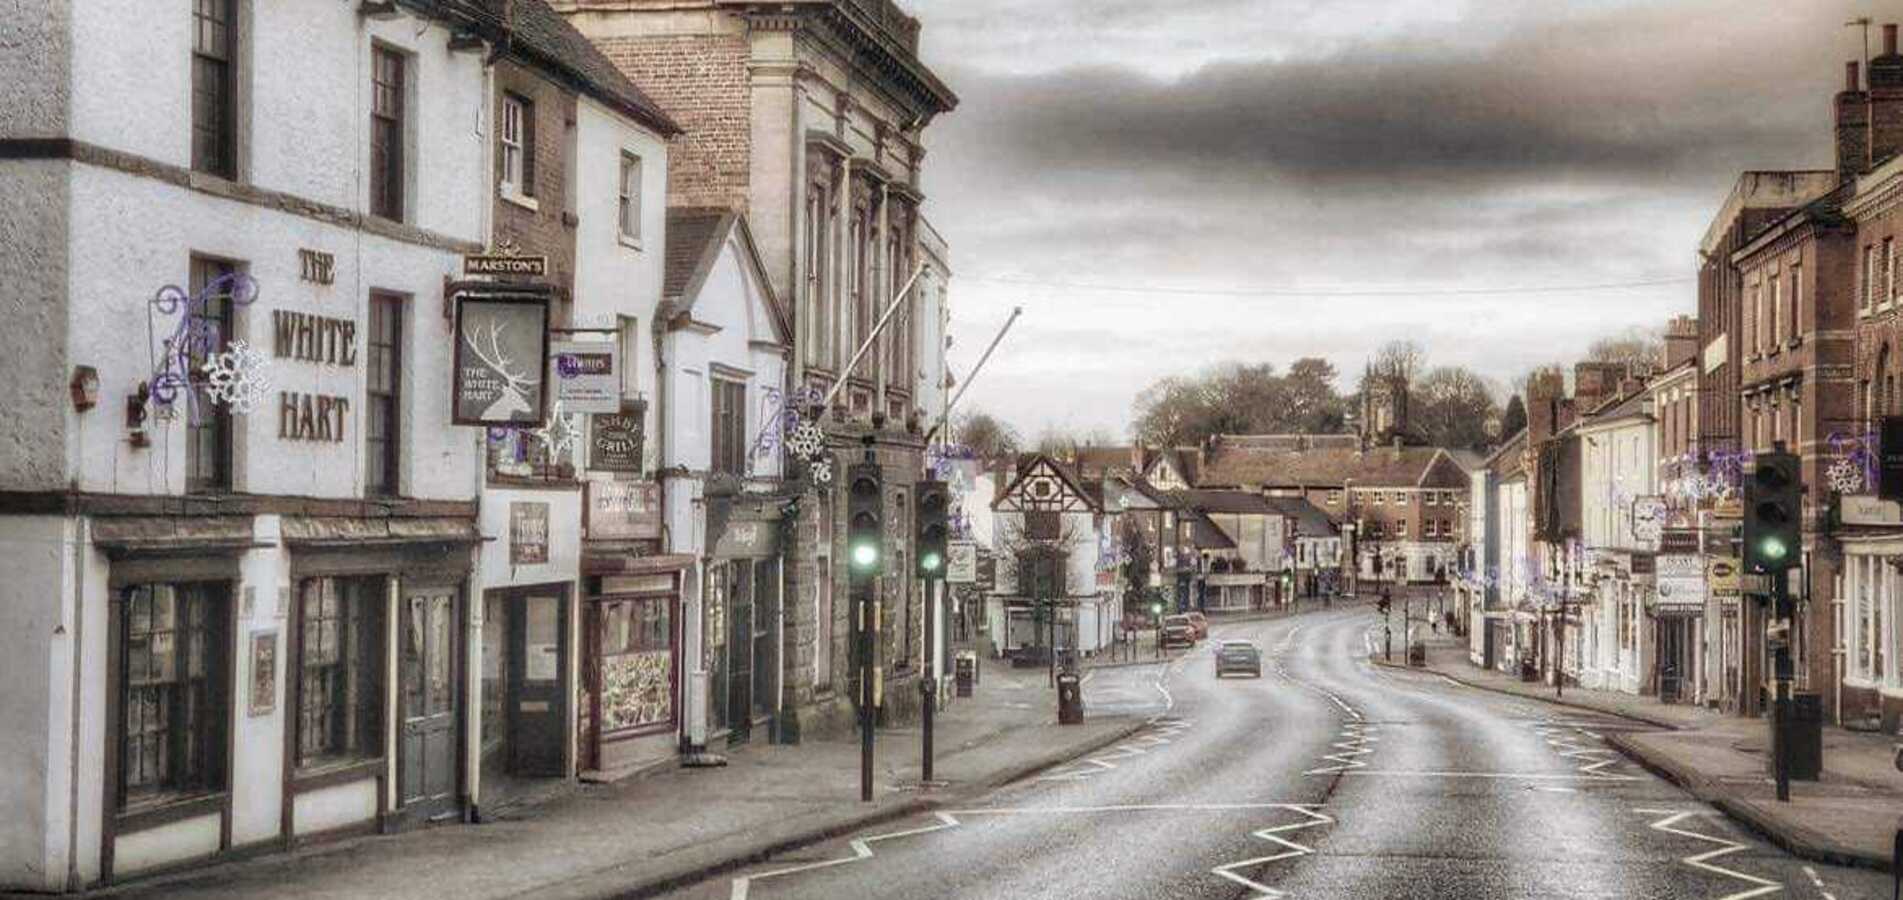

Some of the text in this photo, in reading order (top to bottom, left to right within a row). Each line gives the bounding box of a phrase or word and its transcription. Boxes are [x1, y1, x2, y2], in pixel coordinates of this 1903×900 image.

[299, 247, 335, 286] THE
[466, 259, 543, 272] MARSTON'S
[273, 309, 356, 367] WHITE
[463, 367, 489, 379] THE
[278, 391, 350, 443] HART
